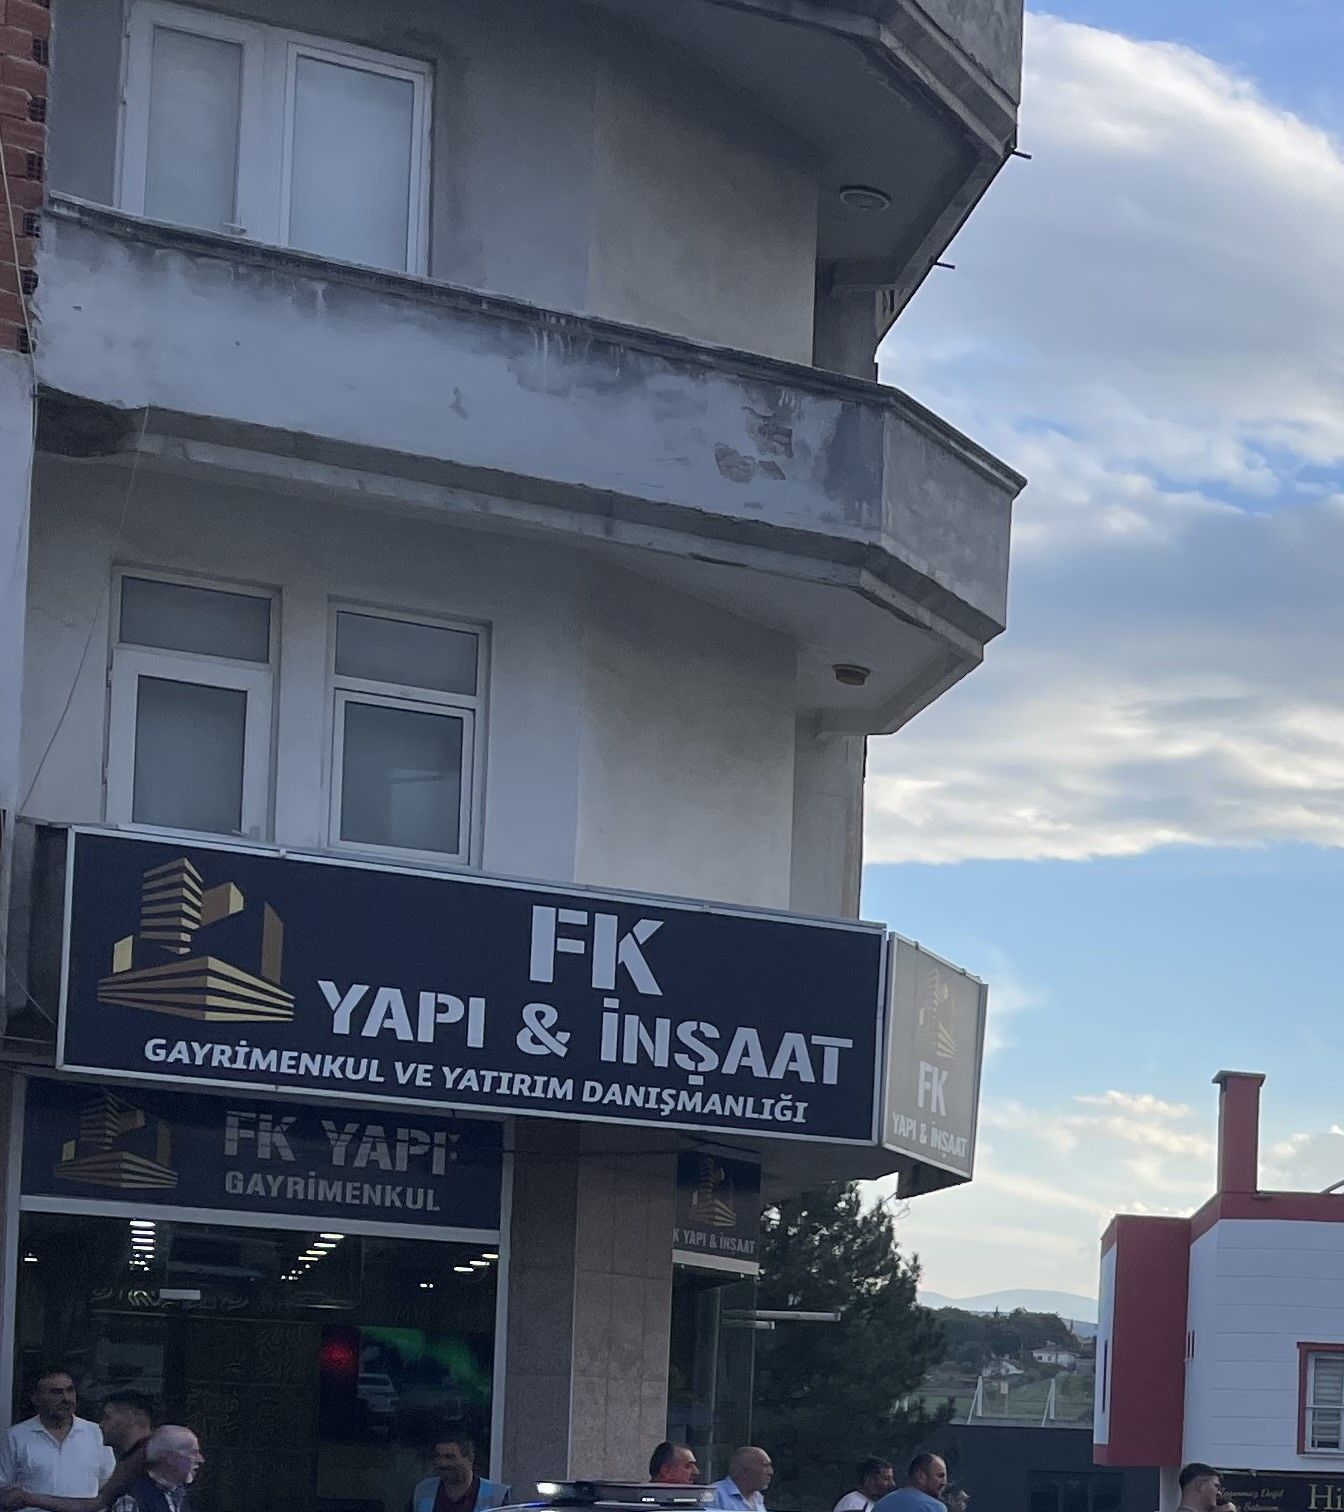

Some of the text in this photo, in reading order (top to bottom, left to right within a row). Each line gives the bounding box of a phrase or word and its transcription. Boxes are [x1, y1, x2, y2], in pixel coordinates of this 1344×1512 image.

[529, 904, 665, 997] FK
[317, 979, 854, 1086] YAPI & İNŞAAT
[144, 1038, 809, 1124] GAYRİMENKUL VE YATIRIM DANIŞMANLIĞI
[918, 1060, 949, 1117] FK
[224, 1110, 447, 1175] FK YAPI
[892, 1112, 917, 1141] YAPI
[919, 1122, 928, 1144] &
[225, 1170, 441, 1212] GAYRİMENKUL
[672, 1228, 680, 1243] K
[683, 1229, 707, 1248] YAPI
